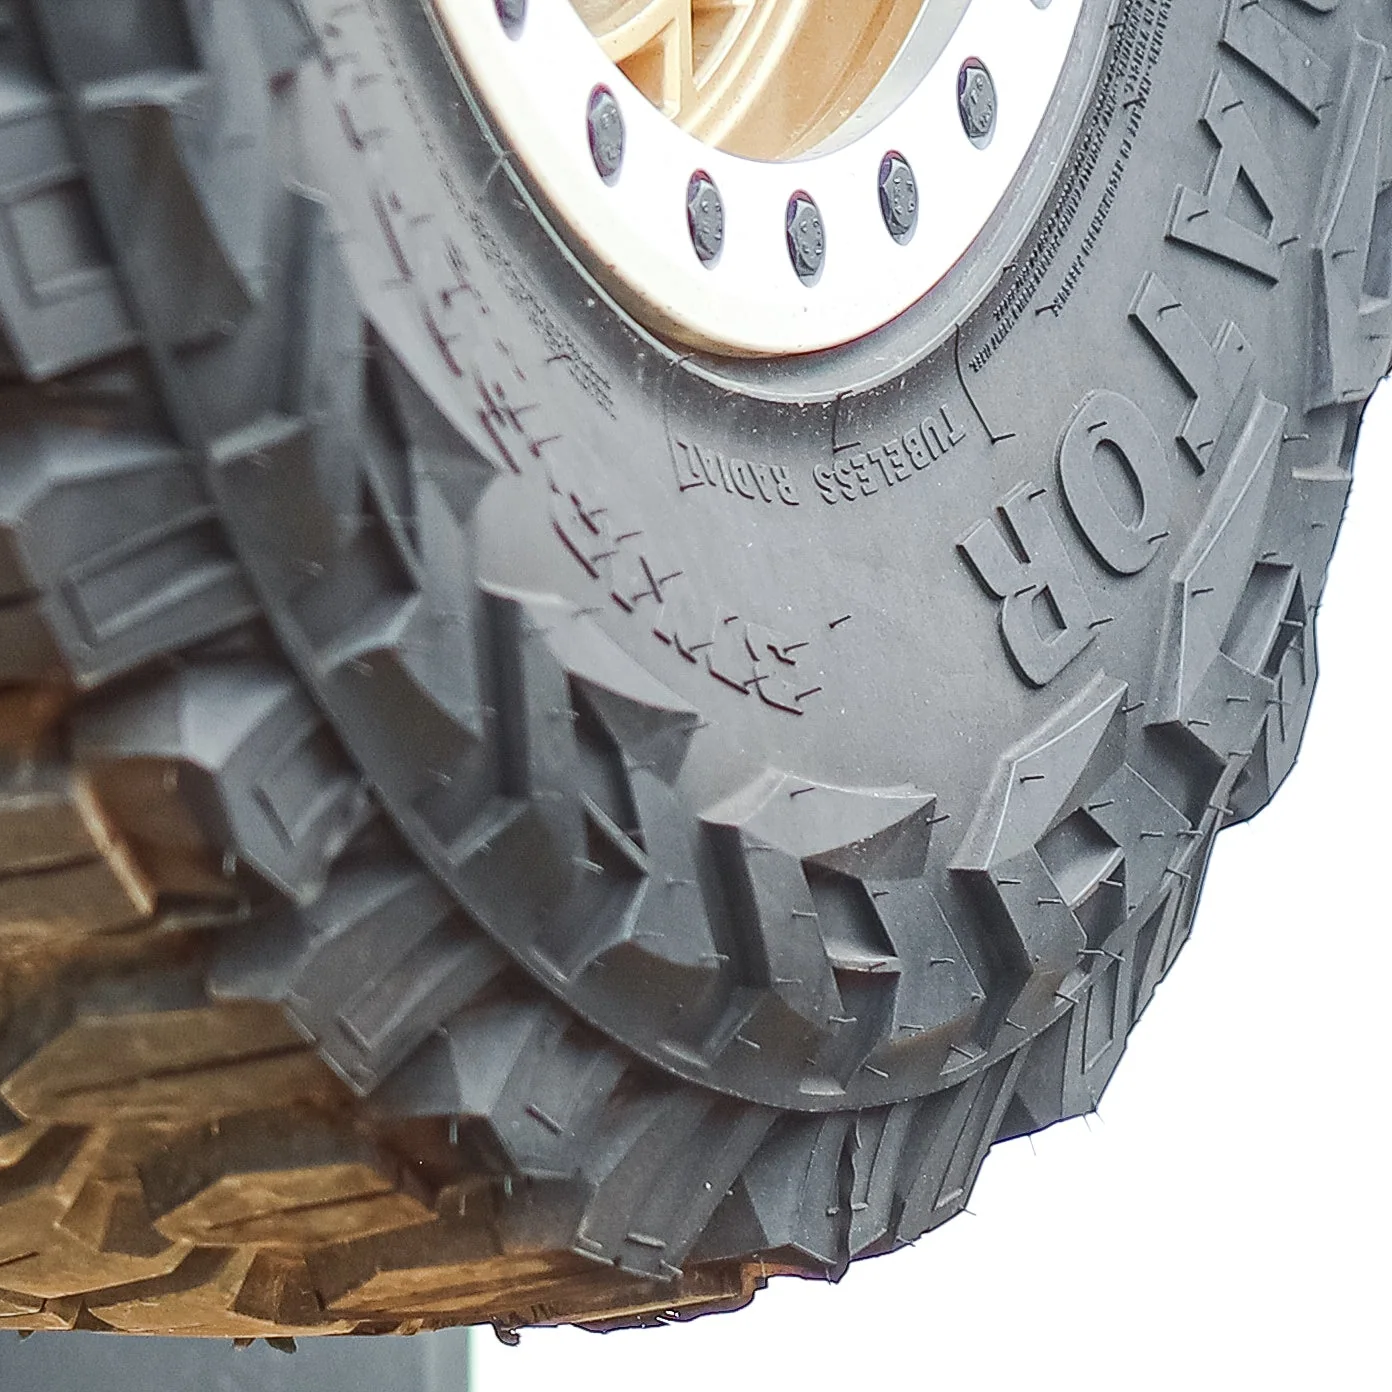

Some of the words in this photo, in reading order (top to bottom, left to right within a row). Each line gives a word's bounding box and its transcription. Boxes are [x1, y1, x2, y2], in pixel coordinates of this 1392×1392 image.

[955, 0, 1338, 688] IATOR
[675, 440, 800, 506] RADIAL
[813, 402, 966, 505] TUBELESS
